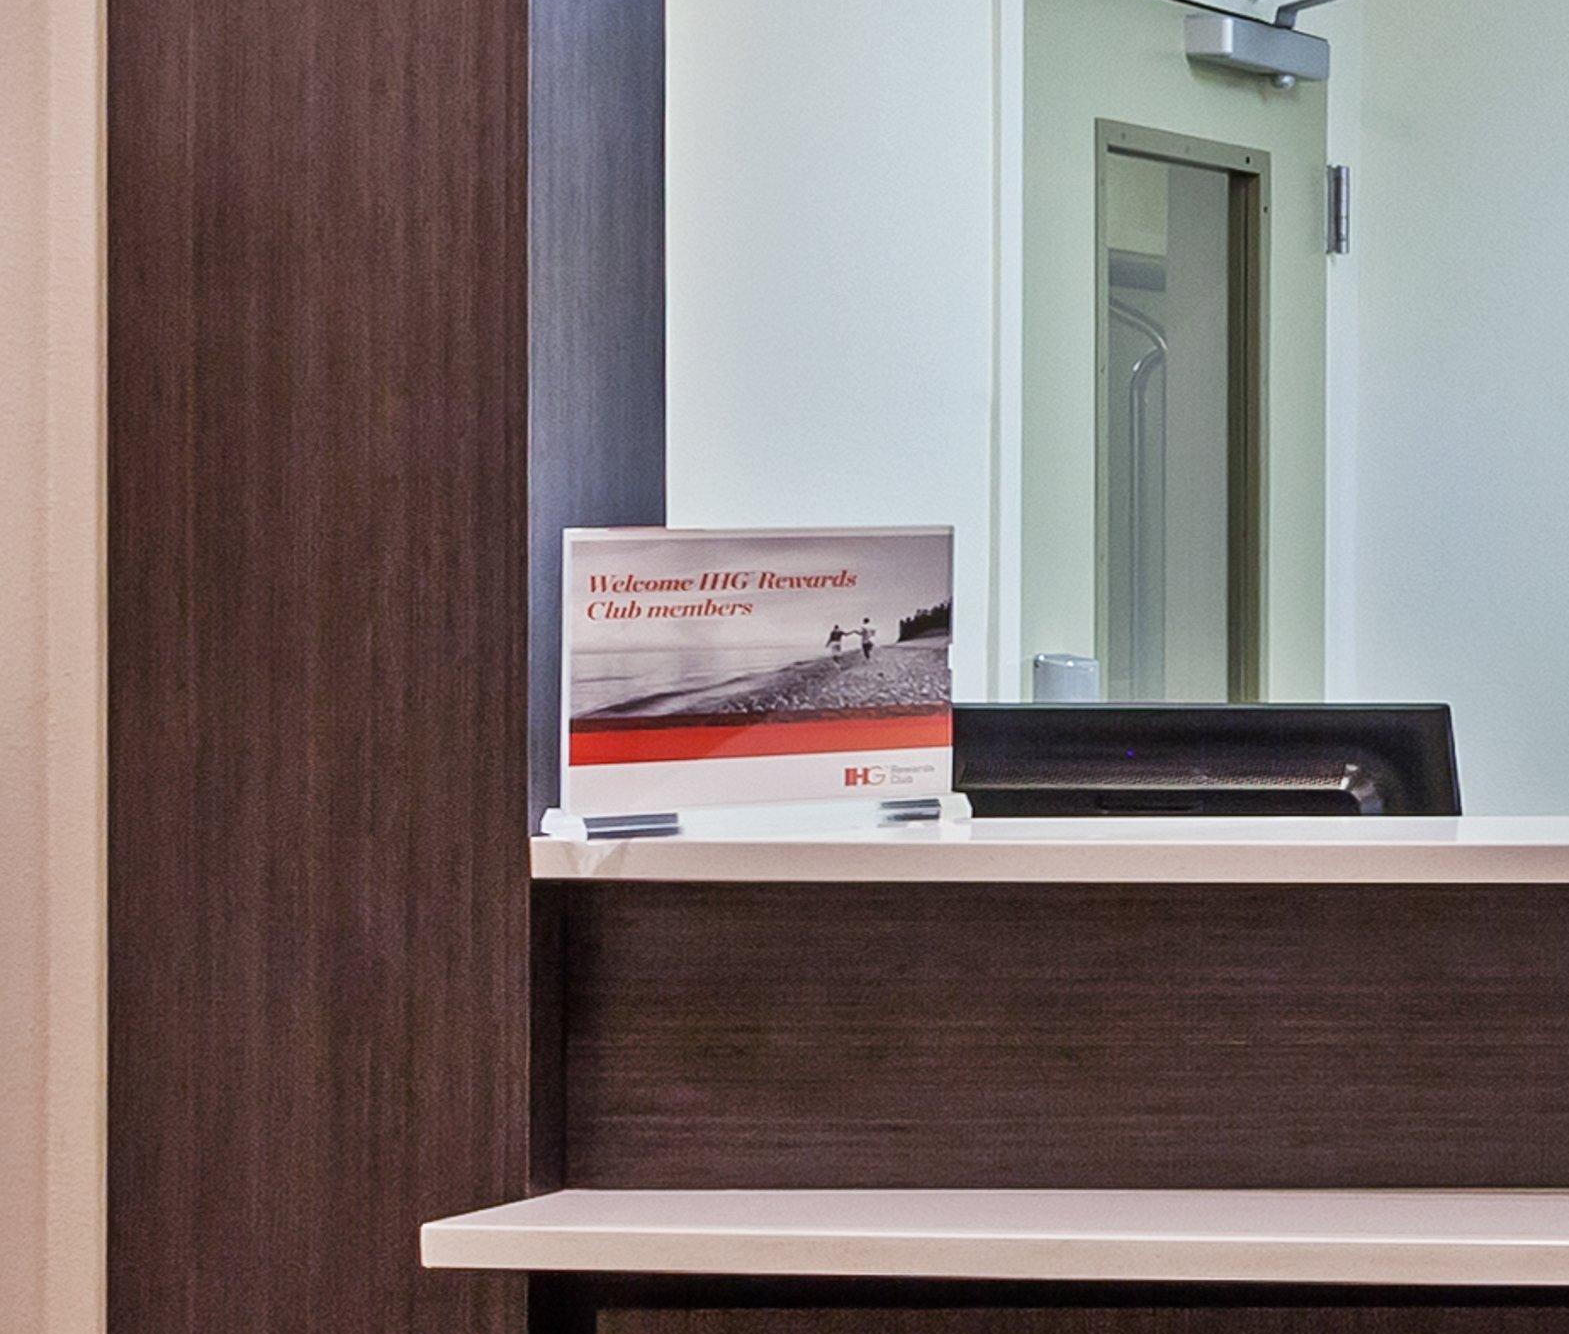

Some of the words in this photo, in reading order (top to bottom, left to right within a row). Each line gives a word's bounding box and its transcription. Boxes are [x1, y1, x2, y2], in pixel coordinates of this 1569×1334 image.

[588, 574, 693, 594] Welcome
[700, 571, 750, 591] IHG
[758, 569, 857, 590] Rewards
[586, 600, 641, 620] Club
[647, 599, 753, 618] members
[845, 766, 886, 786] IHG
